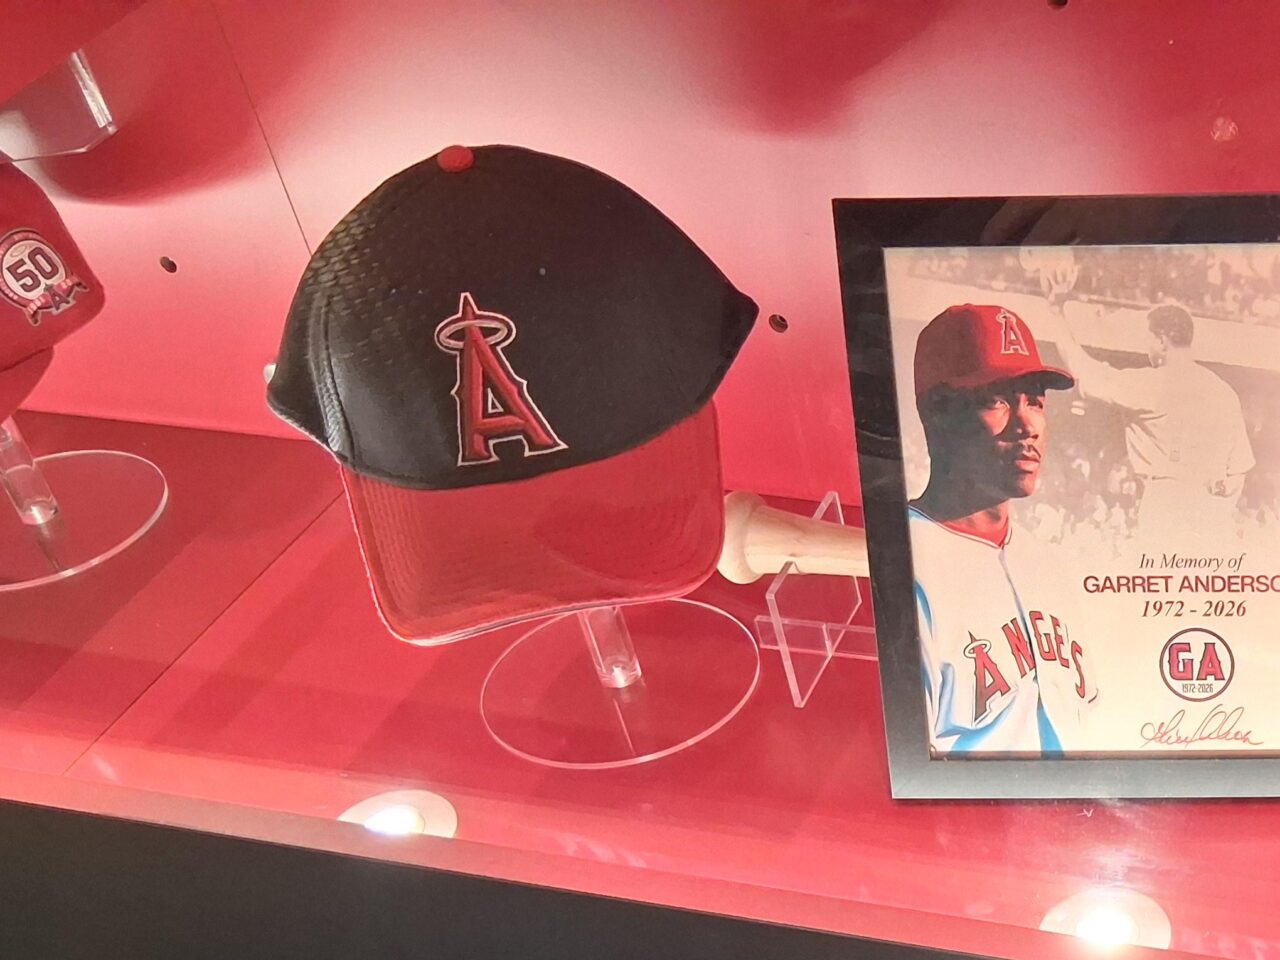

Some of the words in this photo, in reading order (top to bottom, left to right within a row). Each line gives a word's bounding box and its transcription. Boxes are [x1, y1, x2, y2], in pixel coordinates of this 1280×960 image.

[5, 247, 59, 292] 50
[996, 309, 1029, 356] A
[435, 287, 568, 466] A
[1140, 554, 1154, 568] In
[1160, 554, 1223, 572] Memory
[1228, 553, 1246, 572] of
[1083, 576, 1173, 593] GARRET
[1141, 600, 1184, 617] 1972
[1203, 600, 1247, 617] 2026
[963, 611, 1086, 725] ANGES
[1168, 642, 1225, 681] GA
[1181, 683, 1214, 694] 1972-2026
